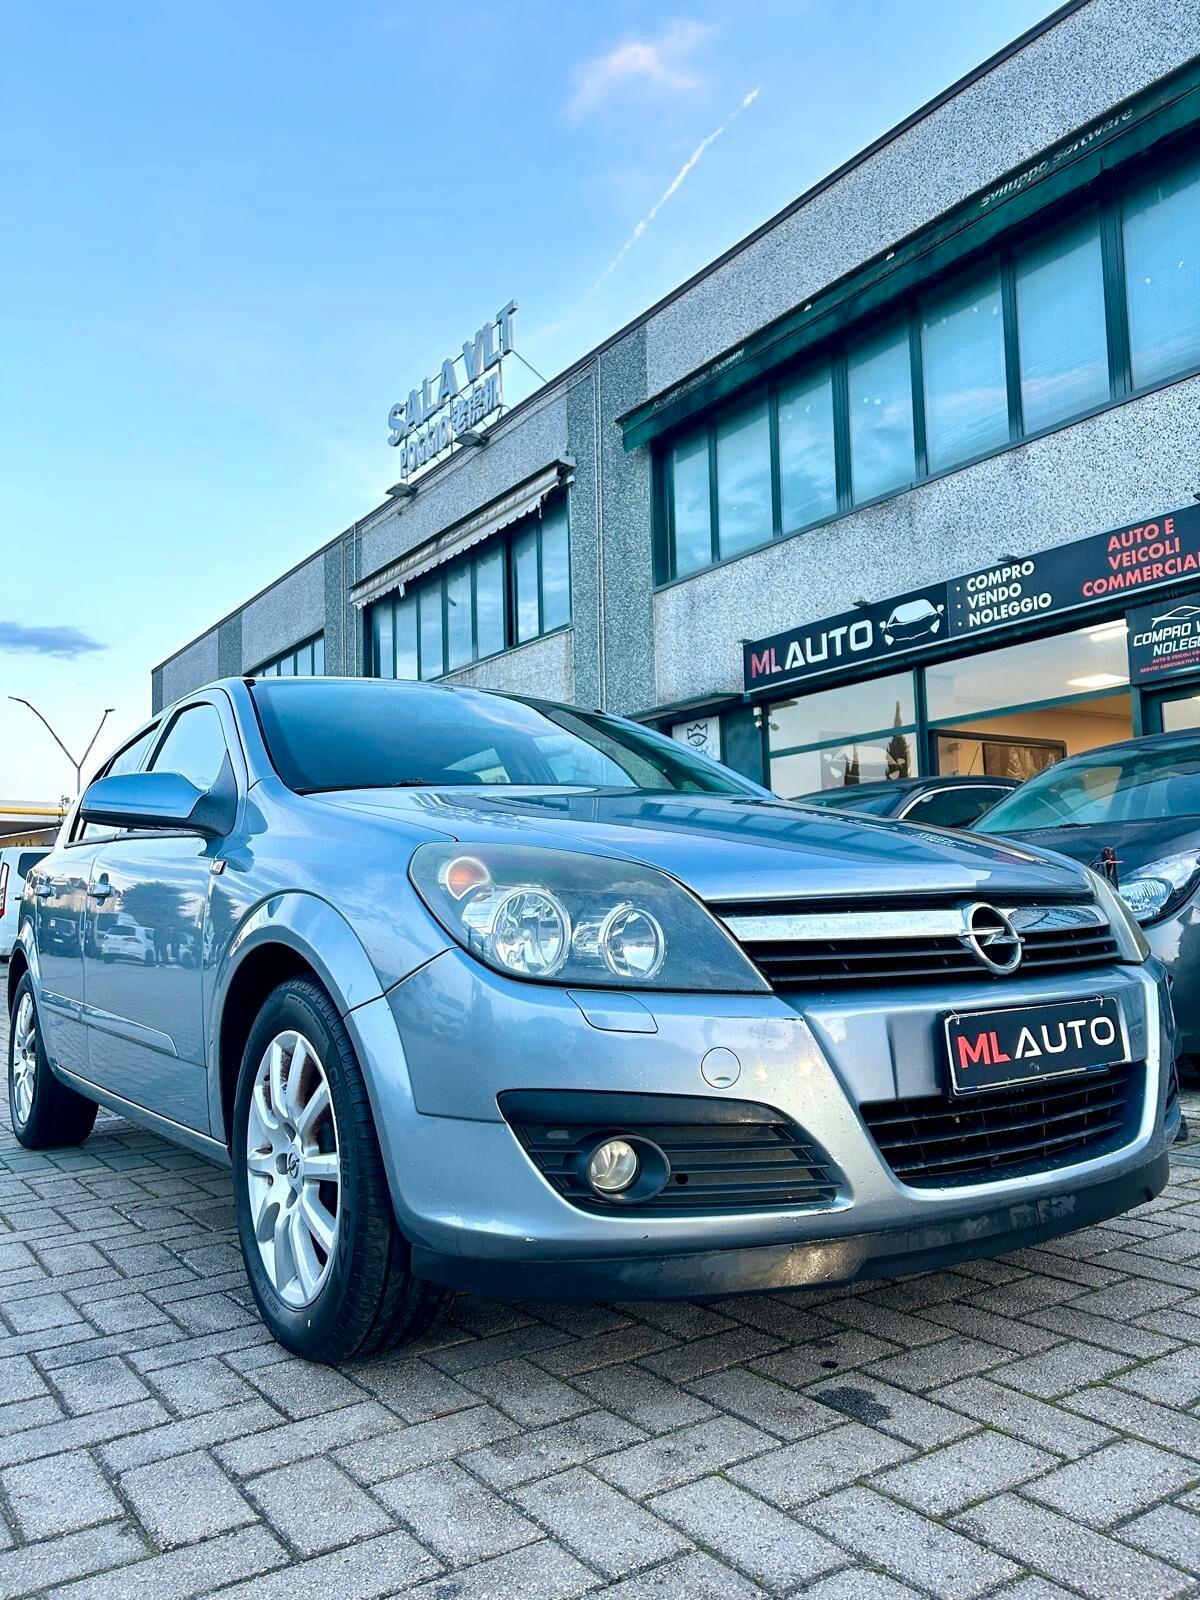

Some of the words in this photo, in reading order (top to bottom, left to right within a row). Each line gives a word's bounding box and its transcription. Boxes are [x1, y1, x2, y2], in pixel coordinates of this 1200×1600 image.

[980, 160, 1048, 207] Sviluppo
[387, 358, 458, 447] SALA
[462, 299, 518, 384] VLT
[400, 415, 453, 478] POGGIO
[1107, 523, 1160, 552] AUTO
[1164, 518, 1175, 535] E
[1108, 537, 1181, 570] VEICOLI
[966, 560, 1035, 592] COMPRO
[967, 582, 1022, 609] VENDO
[968, 592, 1052, 627] NOLEGGIO
[1133, 622, 1192, 647] COMPRO
